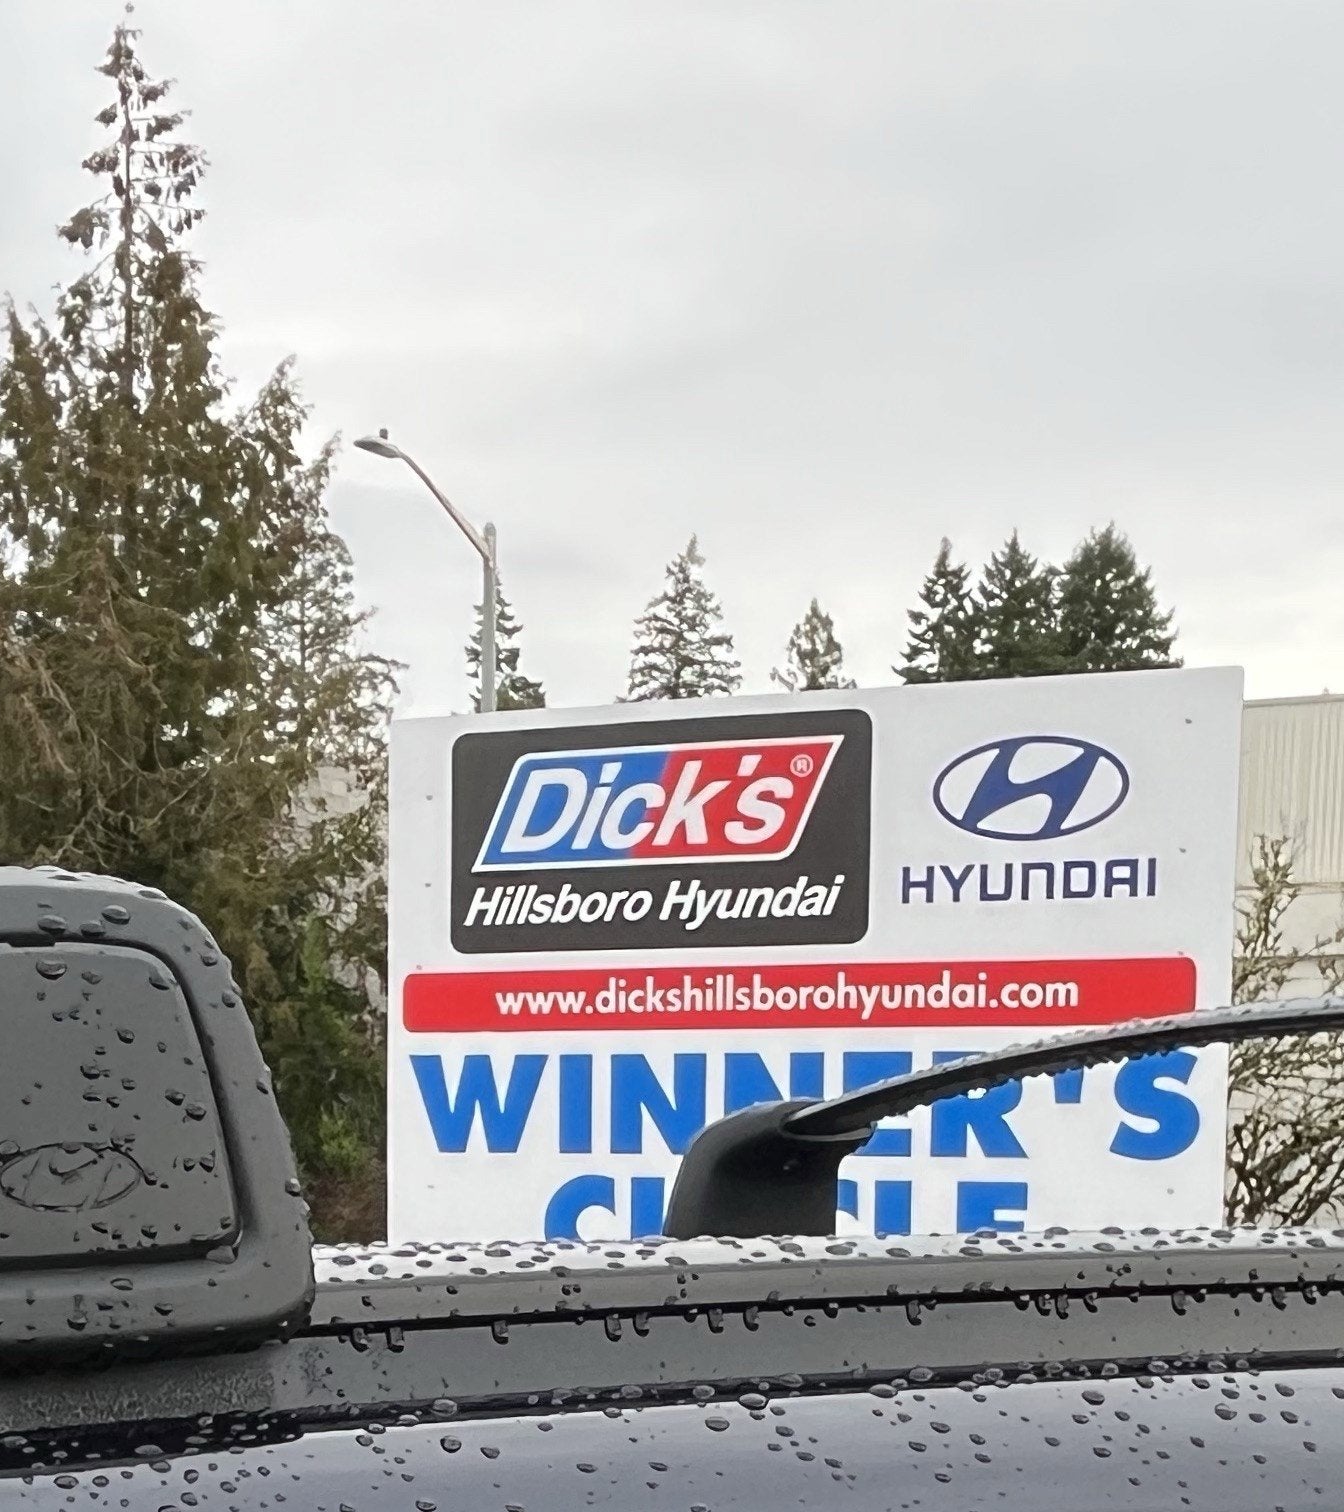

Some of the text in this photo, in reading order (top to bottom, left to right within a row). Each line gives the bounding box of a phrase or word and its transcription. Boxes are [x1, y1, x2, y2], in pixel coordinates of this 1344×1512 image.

[500, 754, 794, 853] Dick's
[463, 874, 845, 931] Hillsboro Hyundai
[901, 857, 1157, 904] HYUNDAI
[494, 969, 1079, 1020] www.dickshillsborohyundai.com
